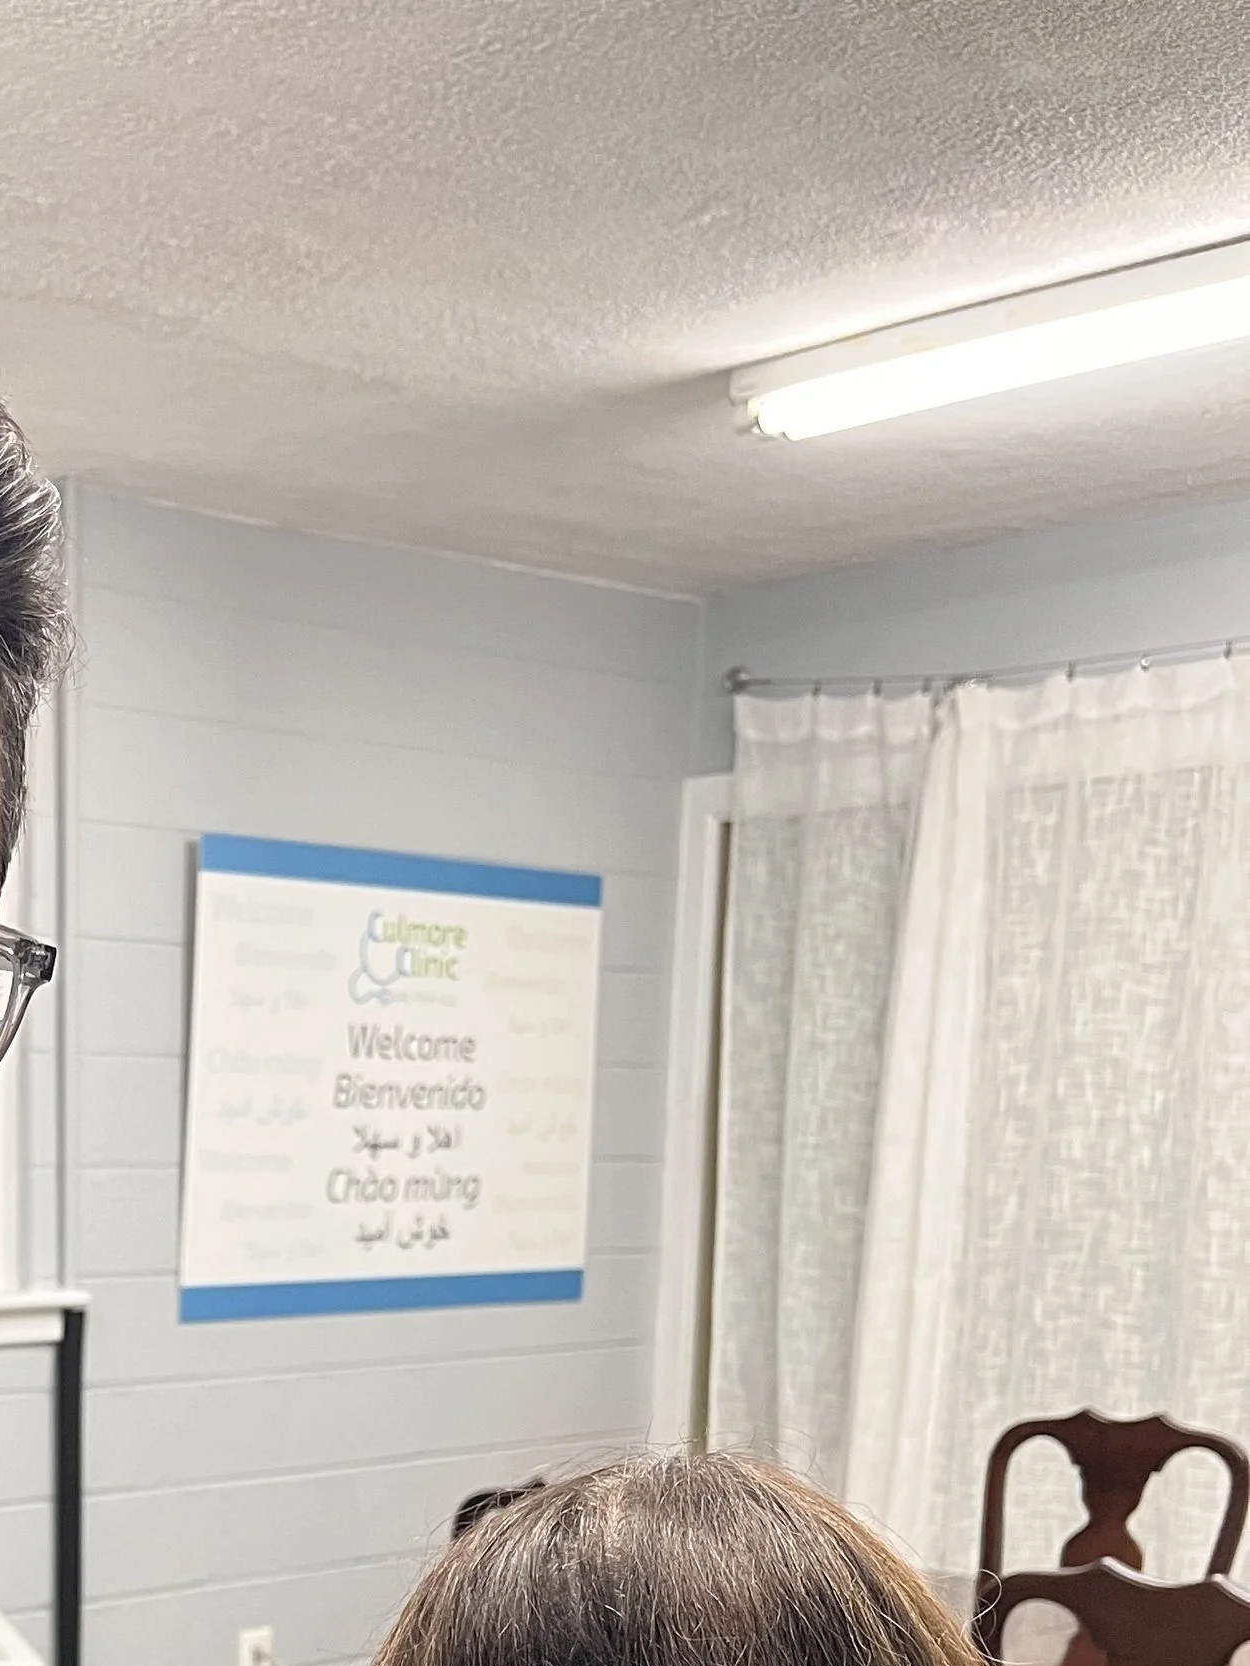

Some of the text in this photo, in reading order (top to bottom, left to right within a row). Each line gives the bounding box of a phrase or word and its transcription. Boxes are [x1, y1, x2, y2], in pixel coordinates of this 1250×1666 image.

[368, 911, 467, 948] Culmore
[396, 942, 459, 980] Clinic
[347, 1023, 478, 1063] Welcome
[332, 1072, 488, 1111] Bienvenido
[326, 1165, 398, 1204] Chào
